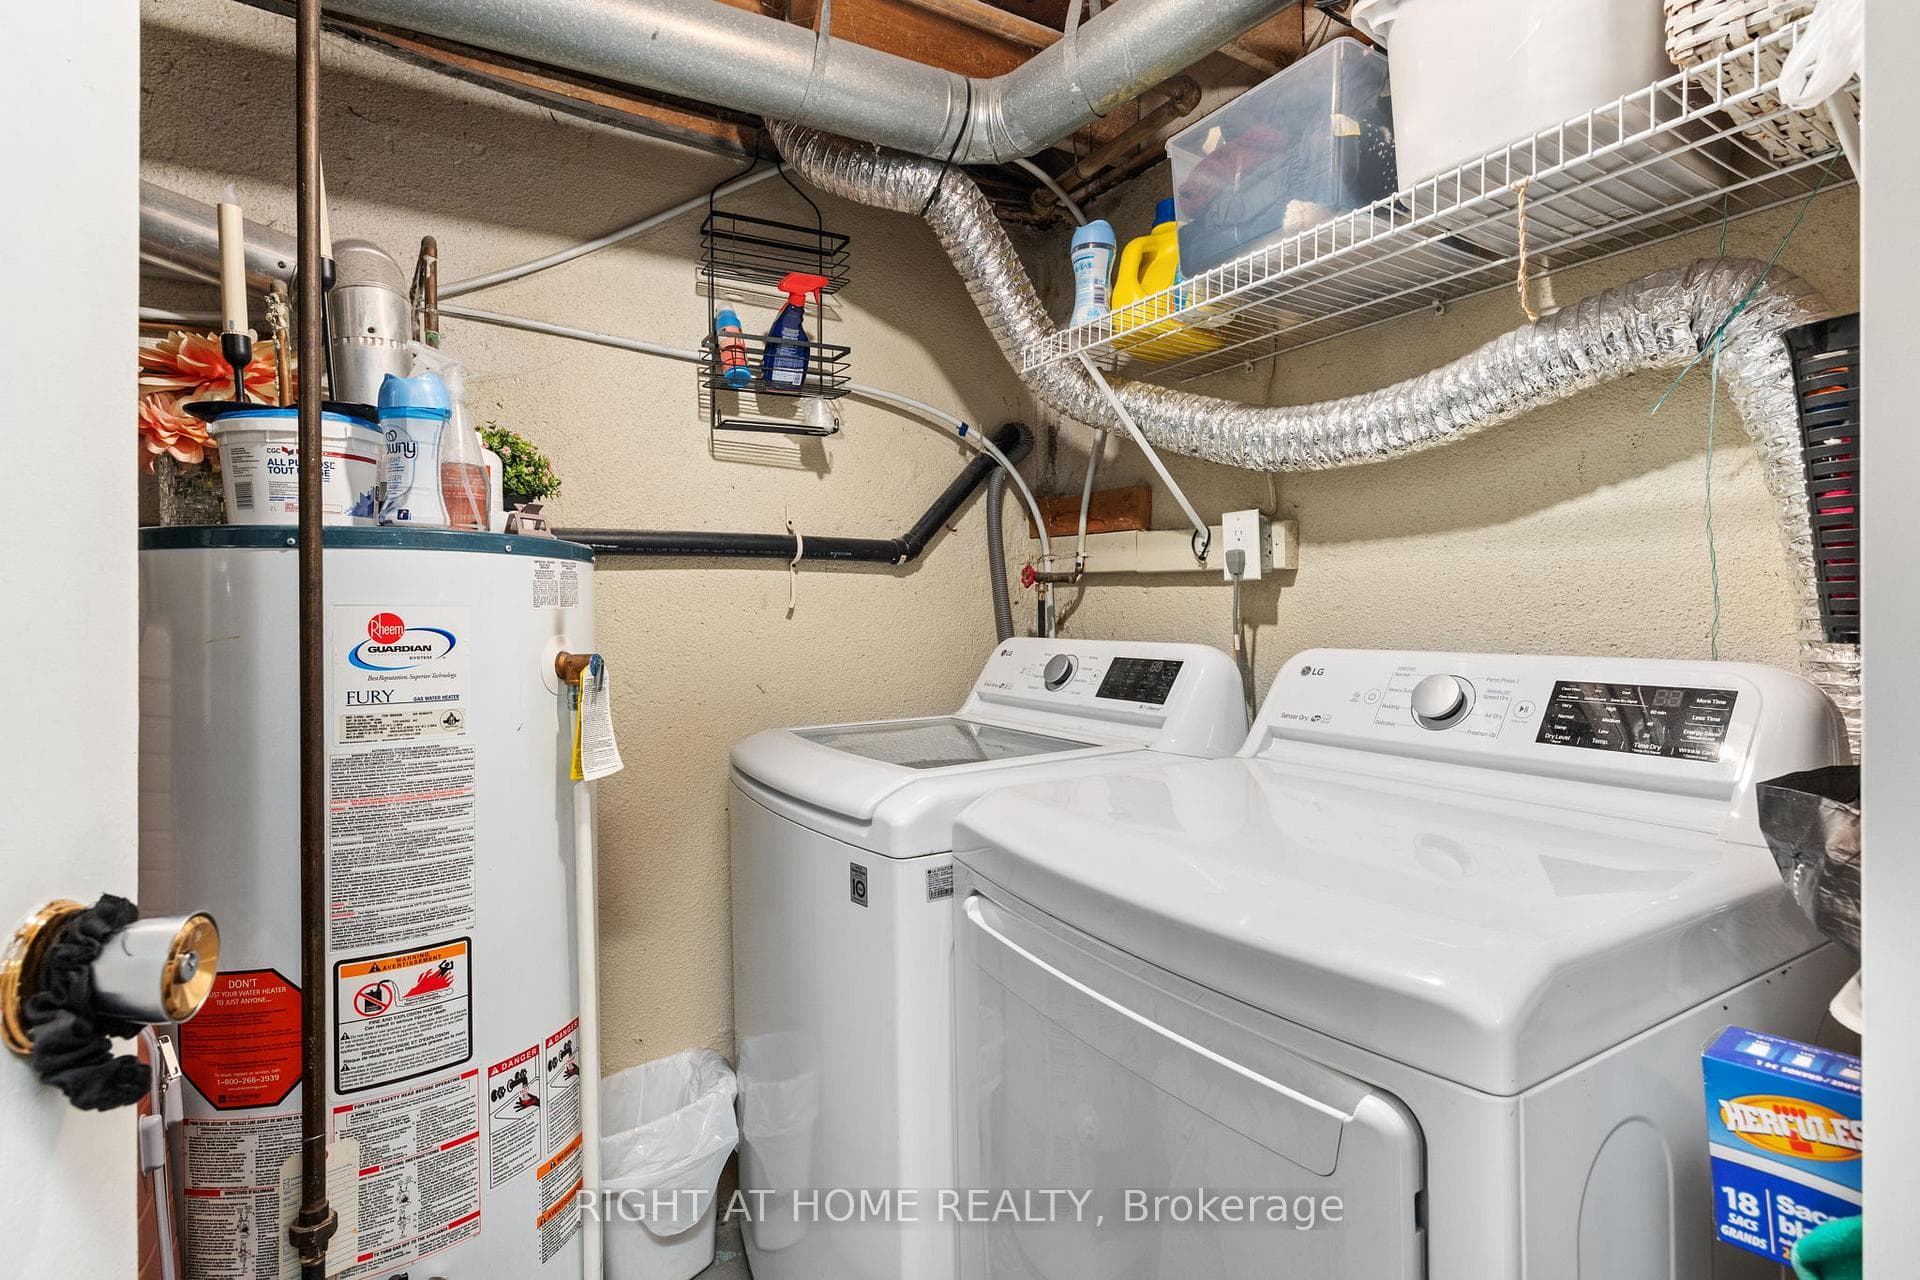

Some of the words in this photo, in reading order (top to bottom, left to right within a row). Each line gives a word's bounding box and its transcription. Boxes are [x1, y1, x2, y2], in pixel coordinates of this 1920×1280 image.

[267, 458, 286, 466] ALL
[267, 466, 295, 475] TOUT
[370, 613, 405, 639] Rheem
[367, 645, 432, 653] GUARDIAN
[1311, 668, 1325, 676] LG
[347, 690, 395, 705] FURY
[382, 954, 442, 971] AVERTISSEMENT
[396, 952, 430, 963] WARNING
[229, 978, 258, 989] DON'T
[240, 989, 261, 997] WATER
[262, 986, 287, 995] HEATER
[502, 1048, 538, 1070] DANGER
[217, 1075, 280, 1086] 1-800-266-3939
[381, 1095, 400, 1103] SAFETY
[415, 1085, 434, 1094] BEFORE
[435, 1077, 460, 1089] OPERATING
[1719, 1099, 1862, 1152] HERCULES
[1722, 1186, 1761, 1218] 18
[1776, 1194, 1838, 1225] Sac
[1728, 1213, 1760, 1232] SACS
[1720, 1225, 1768, 1250] GRANDS
